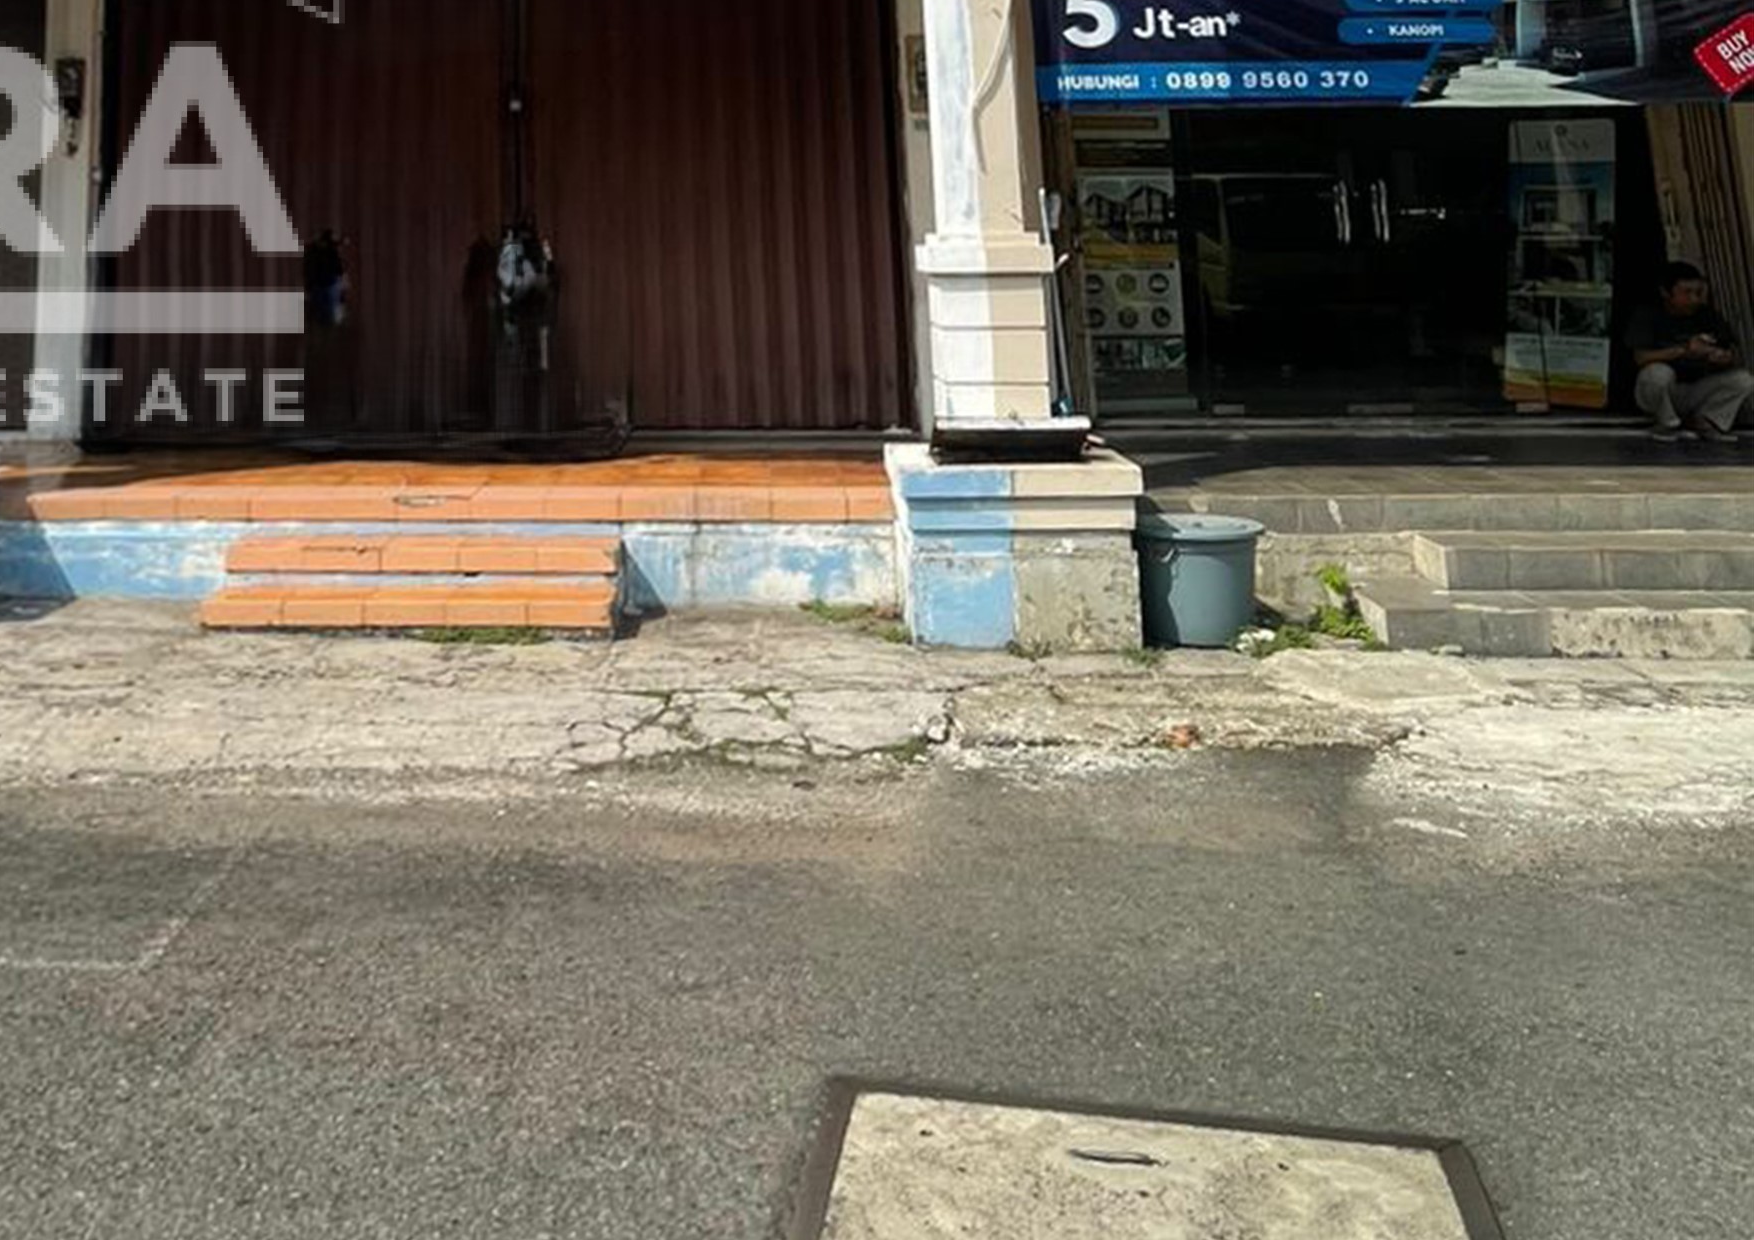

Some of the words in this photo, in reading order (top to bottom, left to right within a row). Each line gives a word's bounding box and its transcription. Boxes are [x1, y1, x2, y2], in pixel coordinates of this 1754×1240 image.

[1388, 24, 1444, 37] KANOPI
[1716, 29, 1750, 61] BUY
[1728, 44, 1754, 76] NO
[1057, 74, 1140, 91] HUBUNGI
[1165, 71, 1232, 90] 0899
[1242, 71, 1309, 89] 9560
[1320, 70, 1370, 89] 370
